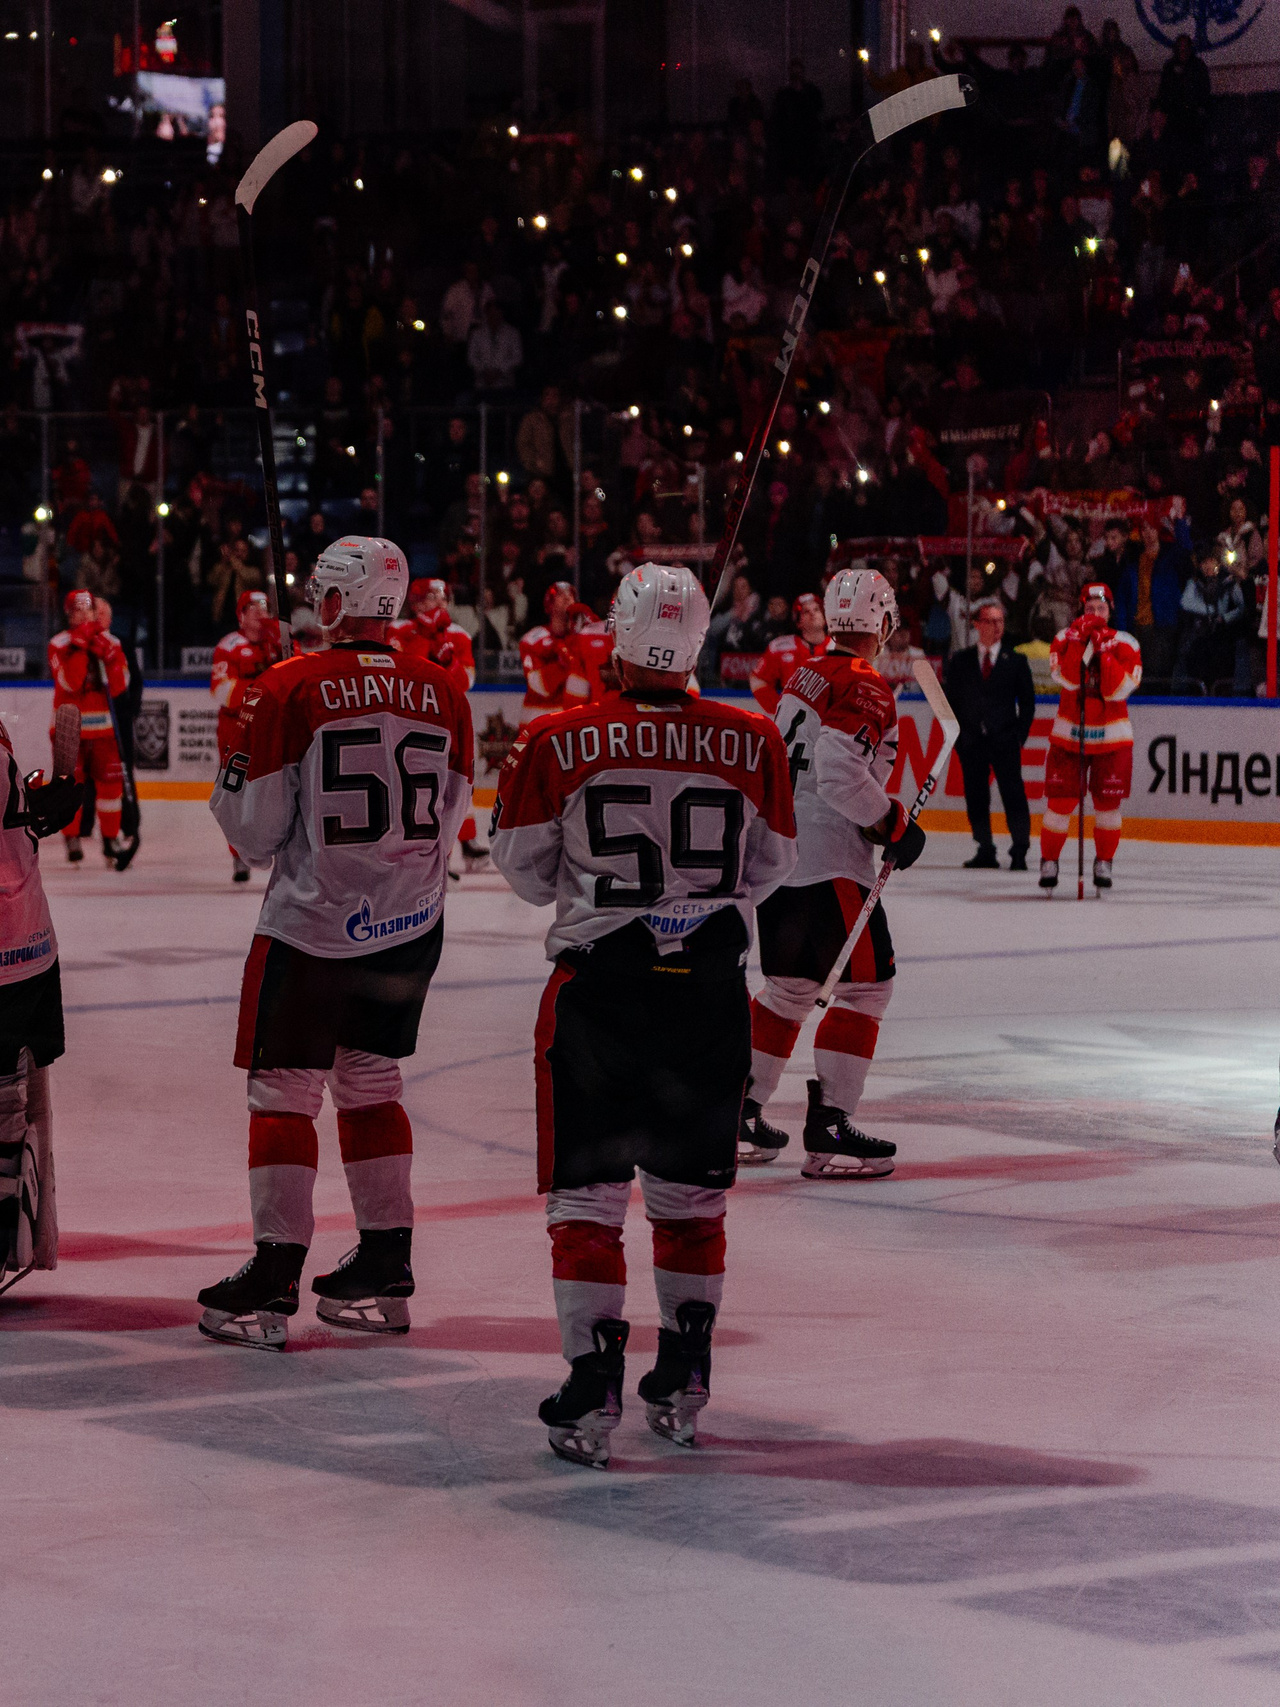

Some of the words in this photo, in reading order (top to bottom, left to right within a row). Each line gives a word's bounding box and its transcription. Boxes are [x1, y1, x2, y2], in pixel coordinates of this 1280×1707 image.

[774, 257, 819, 375] CCM
[246, 309, 268, 409] CCM
[378, 597, 395, 615] 56
[662, 604, 681, 612] FON
[838, 618, 854, 631] 44
[646, 647, 675, 669] 59
[319, 674, 440, 715] CHAYKA
[550, 720, 766, 773] VORONKOV
[1148, 734, 1280, 804] Янде
[322, 727, 447, 846] 56
[910, 773, 936, 821] CCM
[584, 784, 744, 908] 59
[673, 904, 703, 915] СЕТЬ
